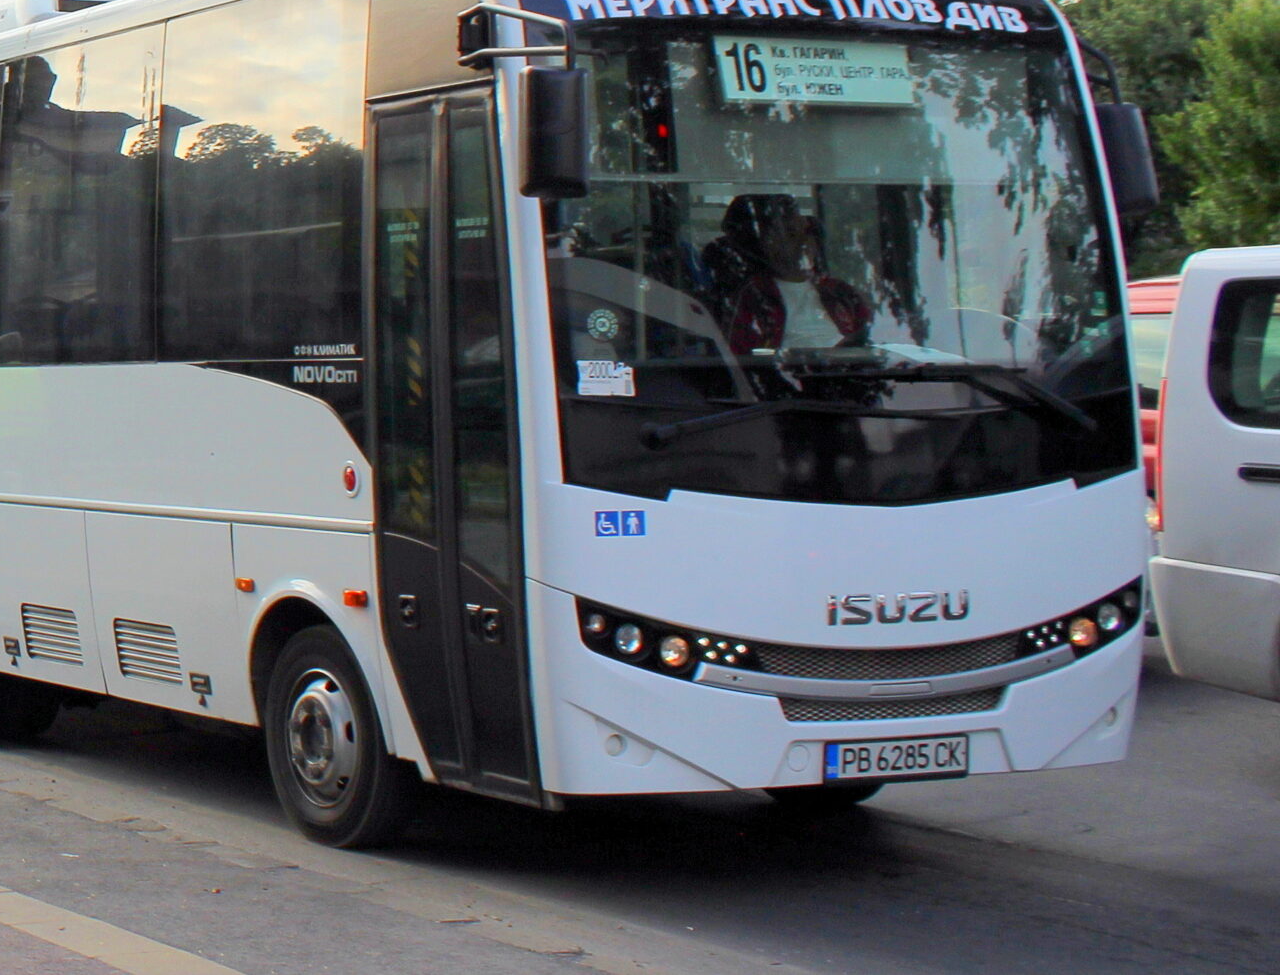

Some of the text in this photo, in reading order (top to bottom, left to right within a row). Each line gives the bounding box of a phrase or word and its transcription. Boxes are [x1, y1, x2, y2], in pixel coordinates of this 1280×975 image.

[725, 42, 767, 93] 16
[805, 82, 844, 96] ЮЖЕН
[841, 741, 961, 774] PB 6285 CK
